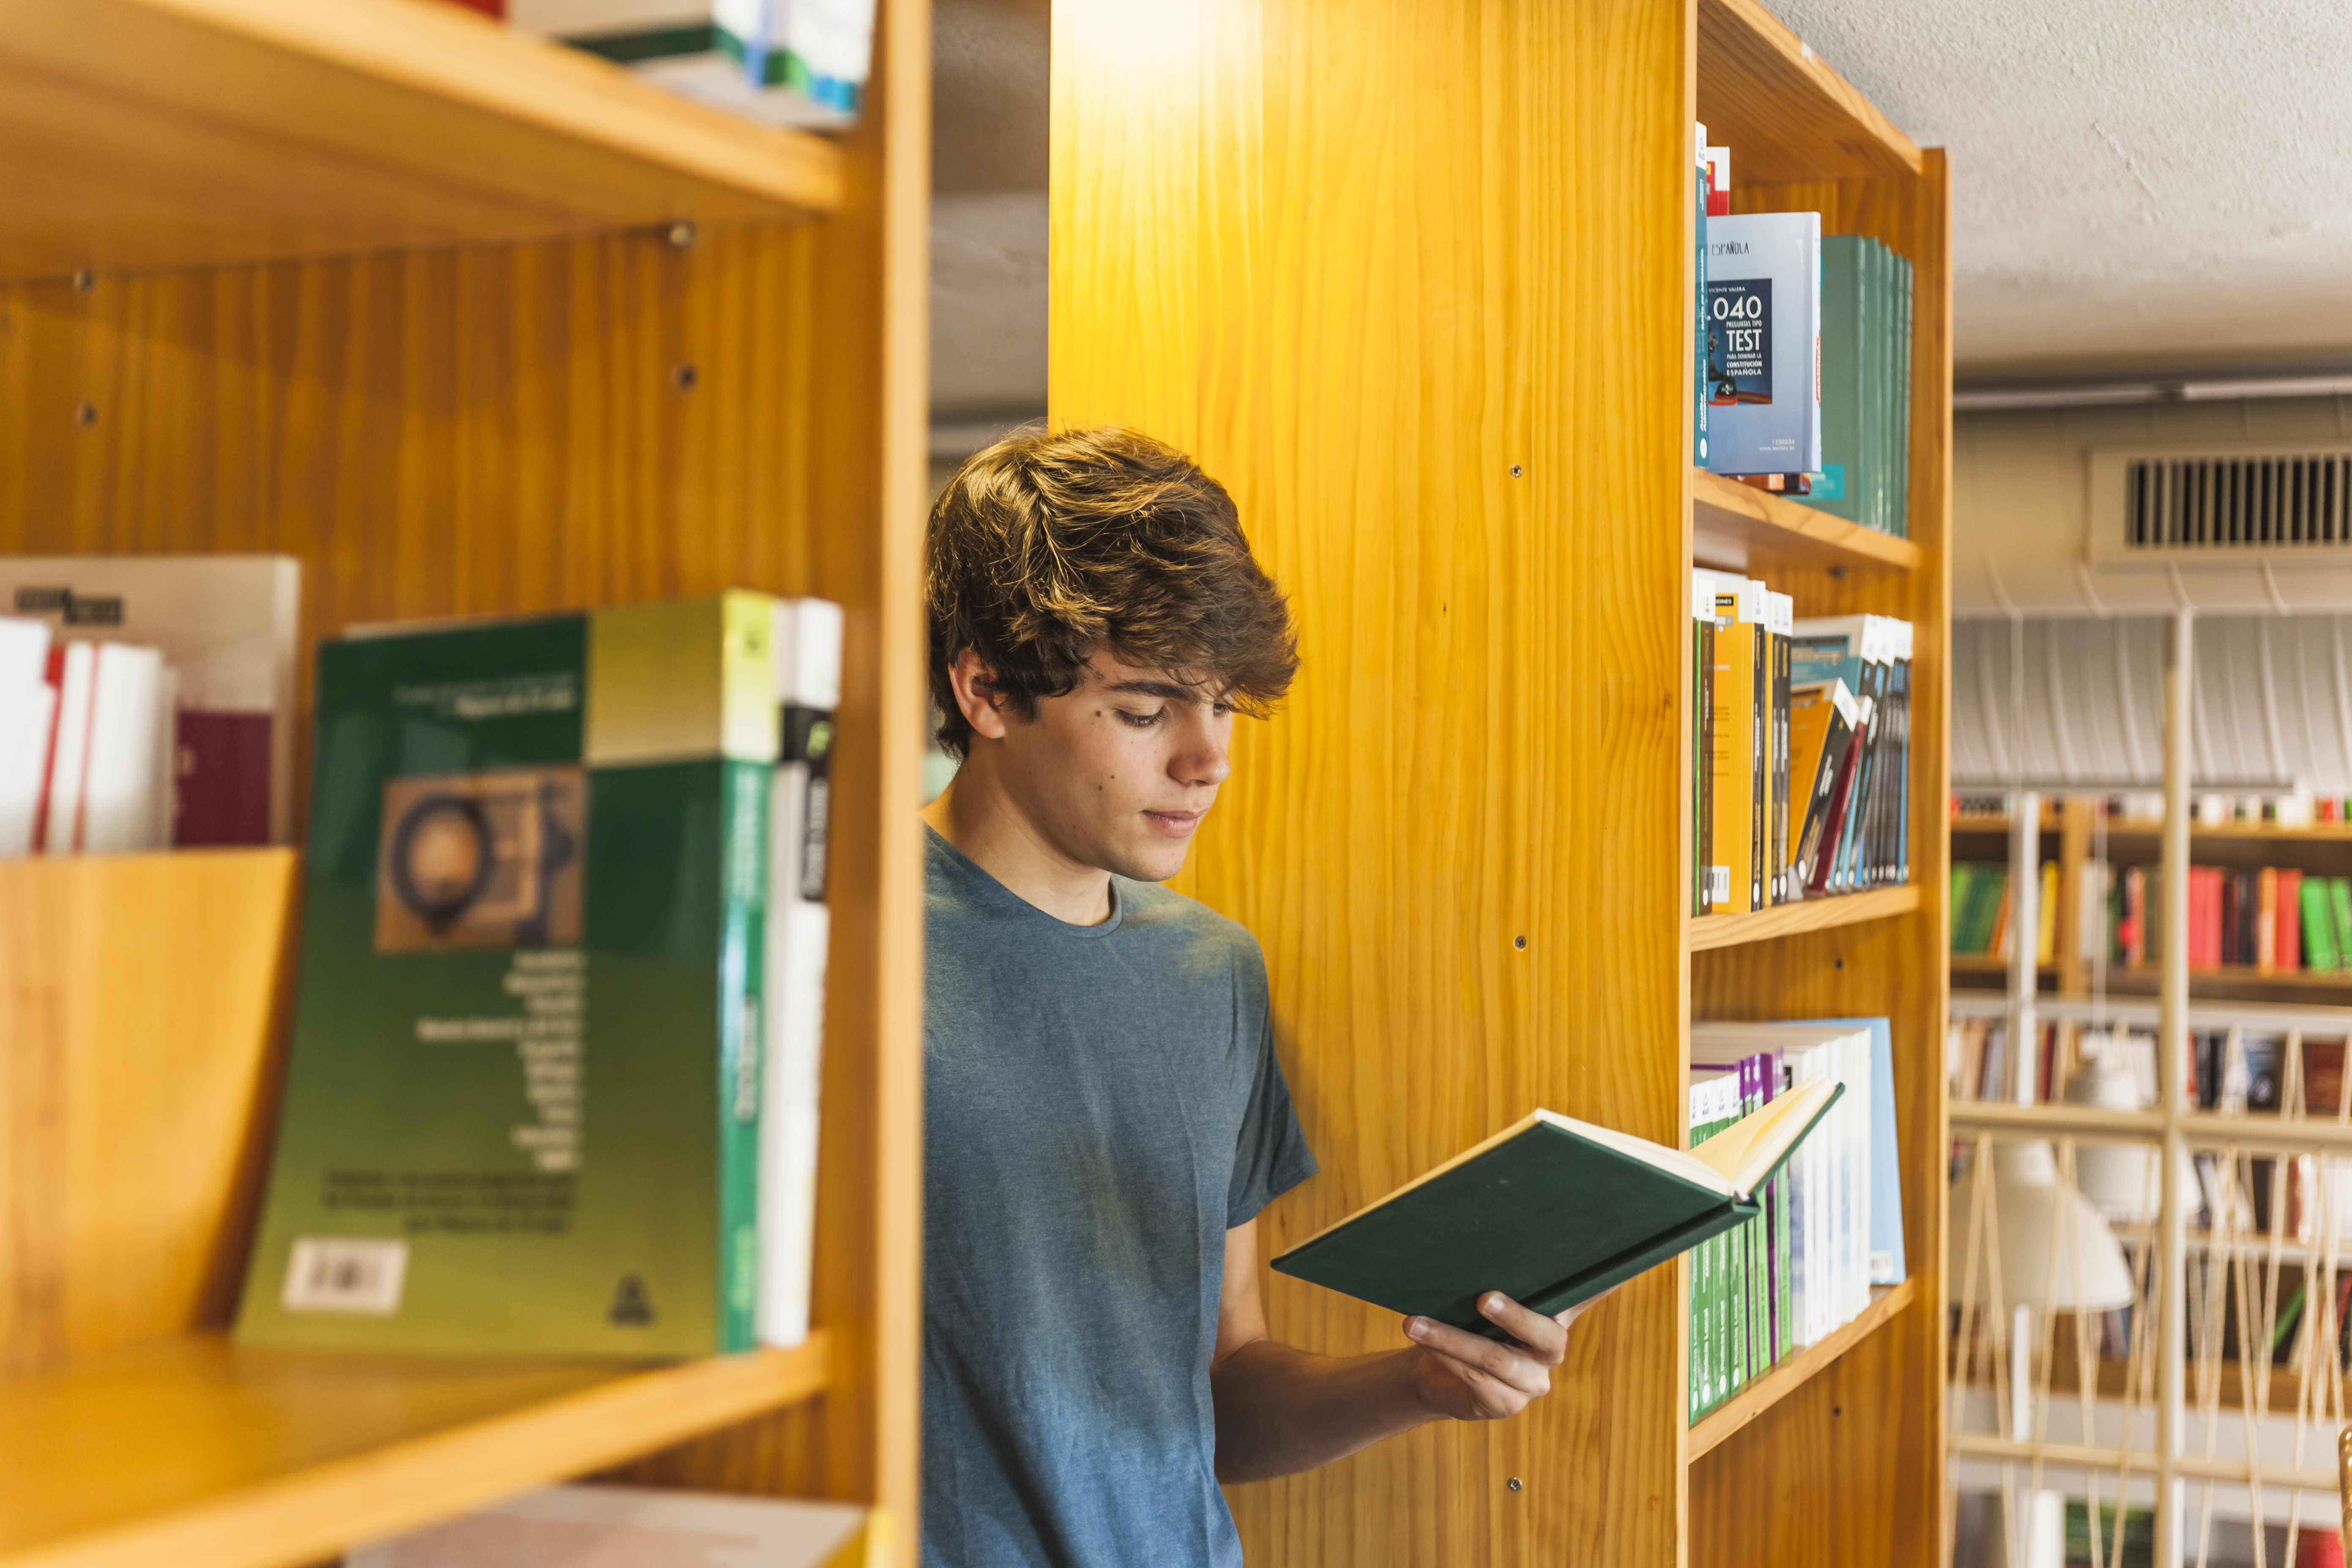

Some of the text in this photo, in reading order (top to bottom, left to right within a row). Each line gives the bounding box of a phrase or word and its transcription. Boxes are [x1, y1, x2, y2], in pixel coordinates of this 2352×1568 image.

[1712, 240, 1750, 256] ESPAÑOLA
[1726, 329, 1762, 351] TEST
[1726, 360, 1762, 368] CONSTITUCIÓN
[1726, 367, 1762, 376] ESPAÑOLA
